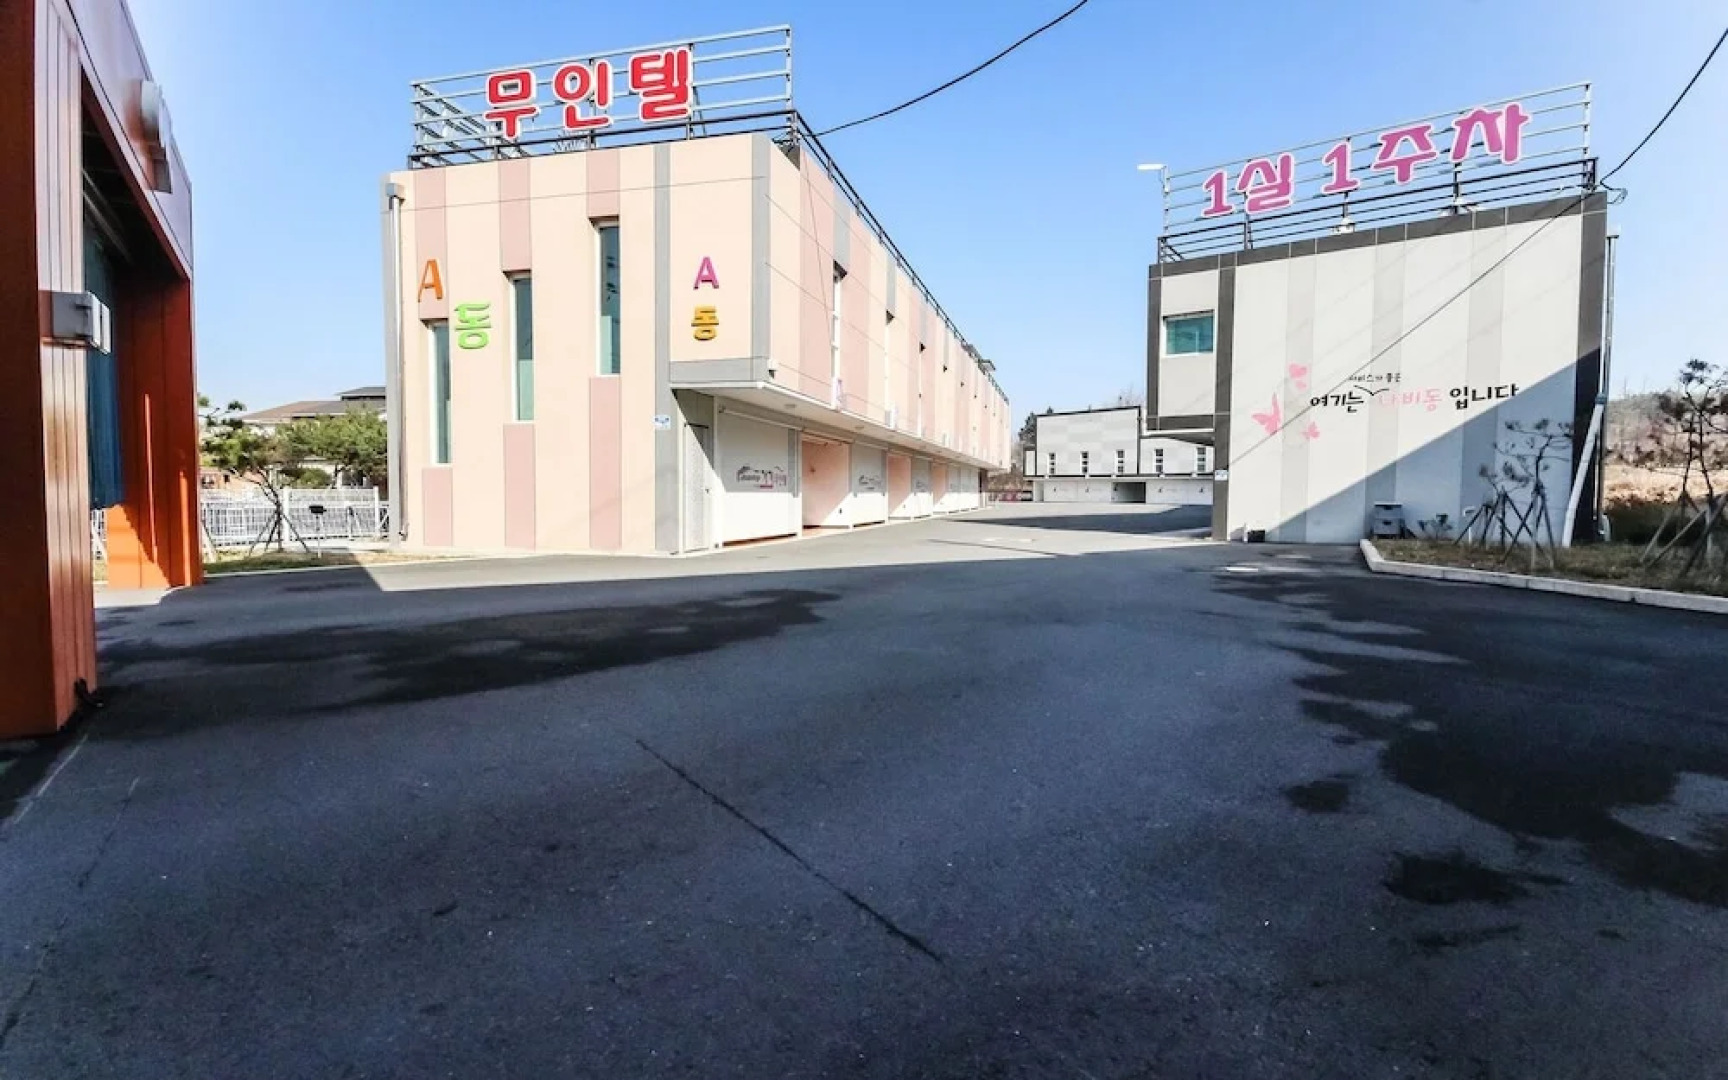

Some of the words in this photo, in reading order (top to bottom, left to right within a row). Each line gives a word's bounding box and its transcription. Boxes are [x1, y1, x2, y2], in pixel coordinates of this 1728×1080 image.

[485, 48, 693, 140] 무인텔
[1203, 154, 1294, 217] 1실
[418, 257, 444, 303] A
[693, 256, 720, 290] A
[454, 301, 493, 350] 동
[691, 306, 720, 342] 동
[1310, 390, 1364, 414] 여기는
[1378, 388, 1443, 413] 나비동
[1449, 383, 1520, 410] 입니다
